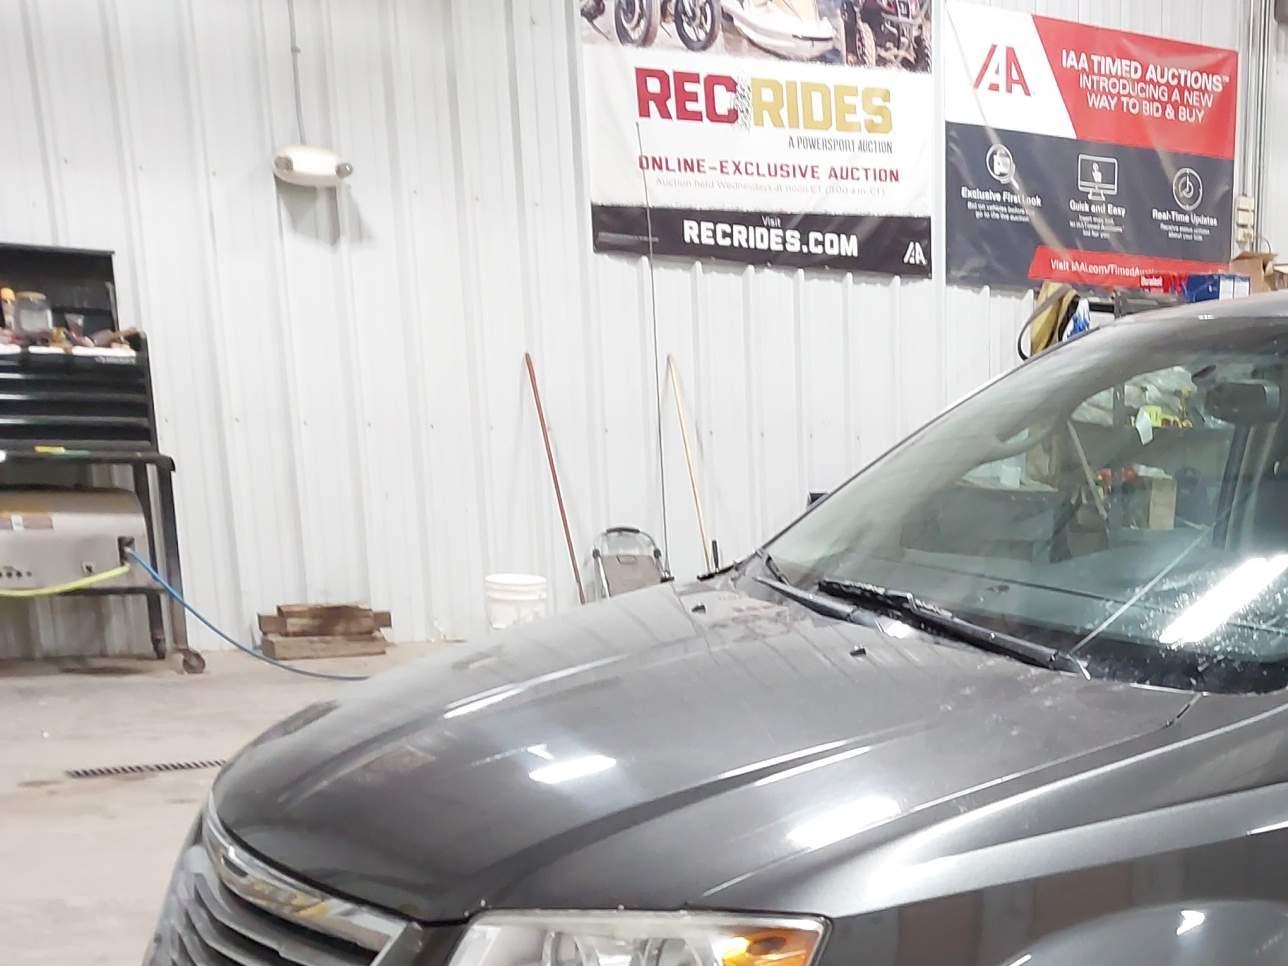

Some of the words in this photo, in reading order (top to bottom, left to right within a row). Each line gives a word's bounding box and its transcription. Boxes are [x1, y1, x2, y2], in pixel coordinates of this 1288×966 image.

[1062, 49, 1089, 72] IAA
[1091, 55, 1142, 79] TIMED
[1080, 73, 1168, 102] INTRODUCING
[1172, 90, 1181, 102] A
[1184, 91, 1214, 108] NEW
[751, 77, 893, 134] RIDES
[1087, 92, 1118, 111] WAY
[1121, 96, 1140, 114] TO
[1143, 101, 1163, 118] BID
[1165, 107, 1176, 120] &
[1179, 107, 1205, 123] BUY
[788, 135, 796, 150] A
[797, 137, 855, 153] POWERSPORT
[857, 139, 893, 154] AUCTION
[638, 155, 820, 179] ONLINE-EXCLUSIVE
[828, 164, 900, 183] AUCTION
[961, 186, 1001, 202] Exclusive
[1003, 191, 1021, 205] First
[1069, 200, 1089, 213] Quick
[1091, 202, 1106, 215] and
[1108, 204, 1126, 218] Easy
[1152, 208, 1189, 223] Real-Time
[1191, 212, 1218, 227] Updates
[761, 215, 782, 227] Visit
[683, 220, 858, 257] RECRIDES.COM
[1051, 258, 1069, 272] Visit
